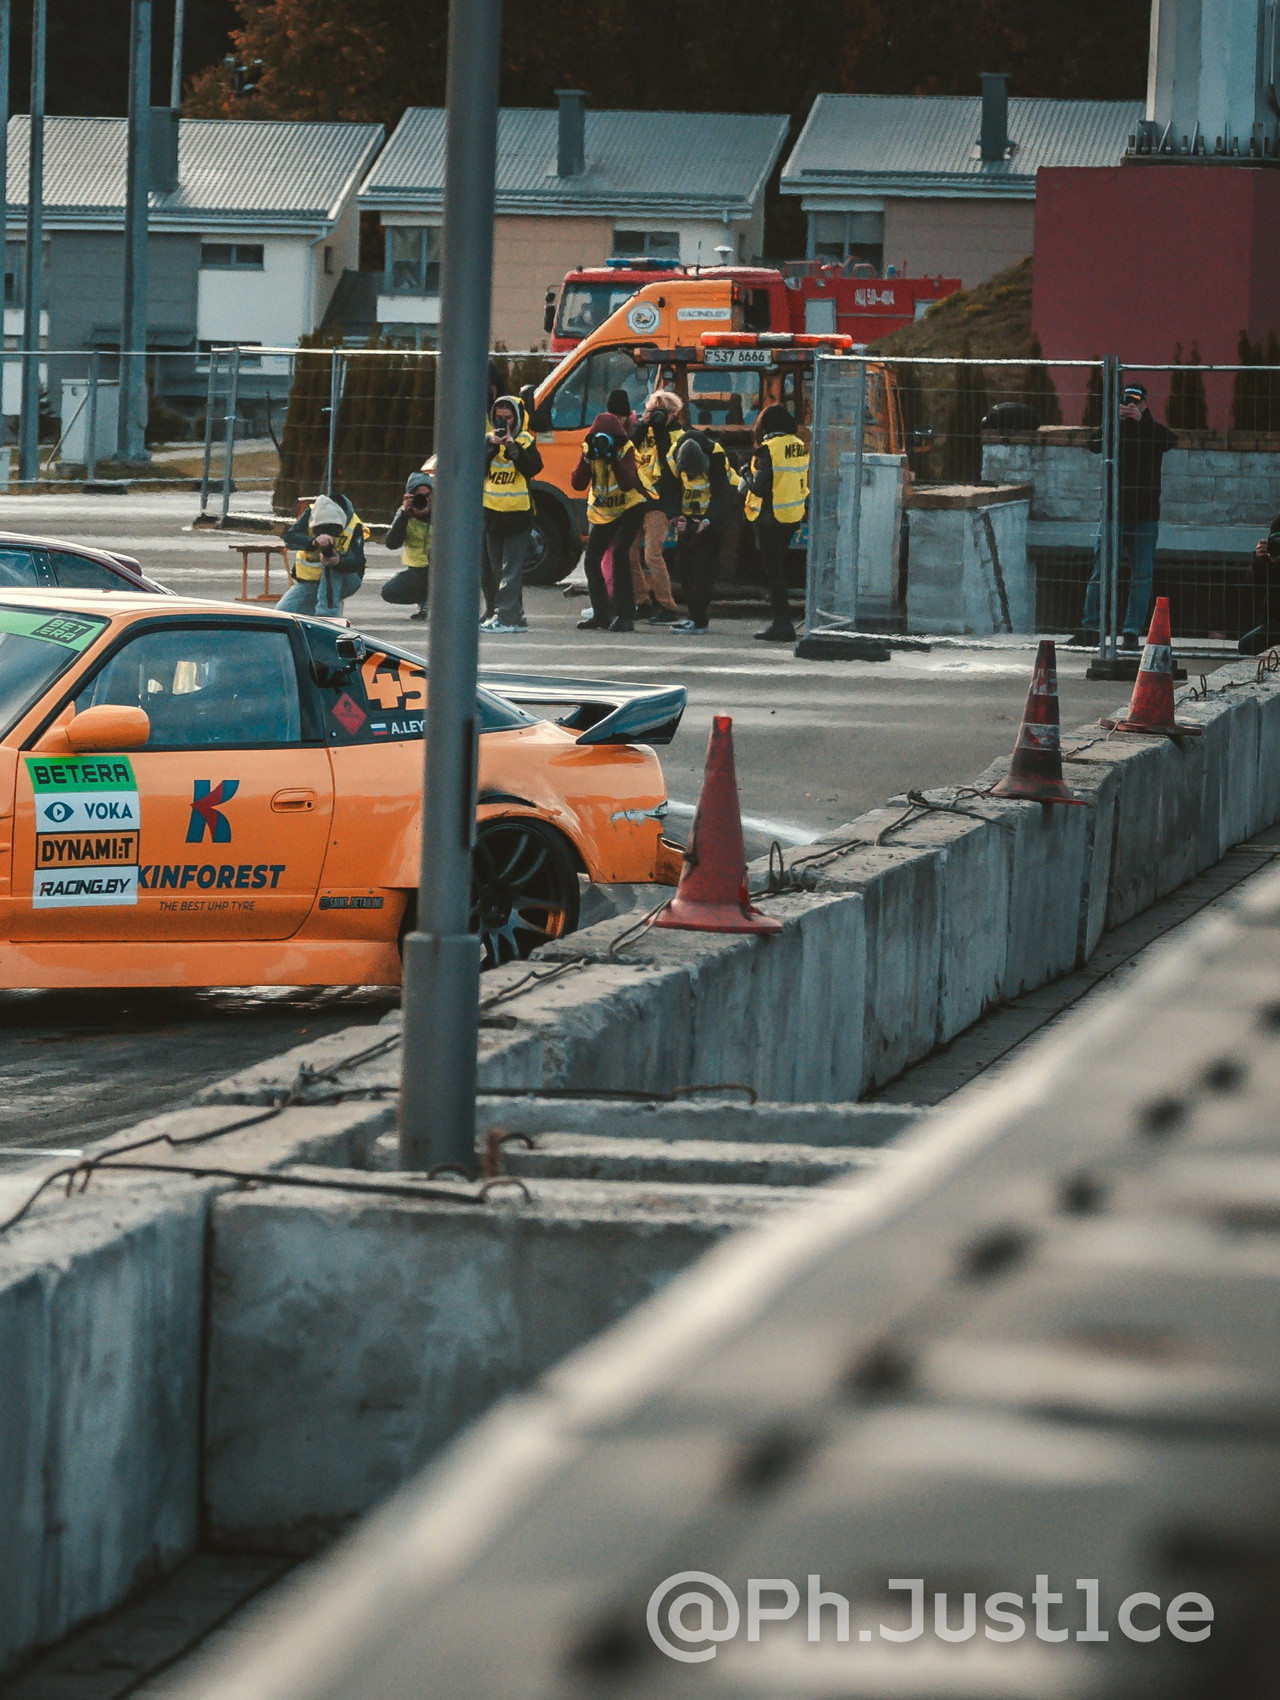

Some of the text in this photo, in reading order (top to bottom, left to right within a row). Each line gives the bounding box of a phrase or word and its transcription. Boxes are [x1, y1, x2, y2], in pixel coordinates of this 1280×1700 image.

[738, 351, 765, 362] 6666
[49, 619, 87, 633] BET
[361, 652, 428, 711] 45
[391, 720, 427, 735] A.LEY
[84, 802, 133, 820] VOKA
[138, 864, 286, 889] KINFOREST
[159, 901, 255, 911] THE BEST UHP TYRE
